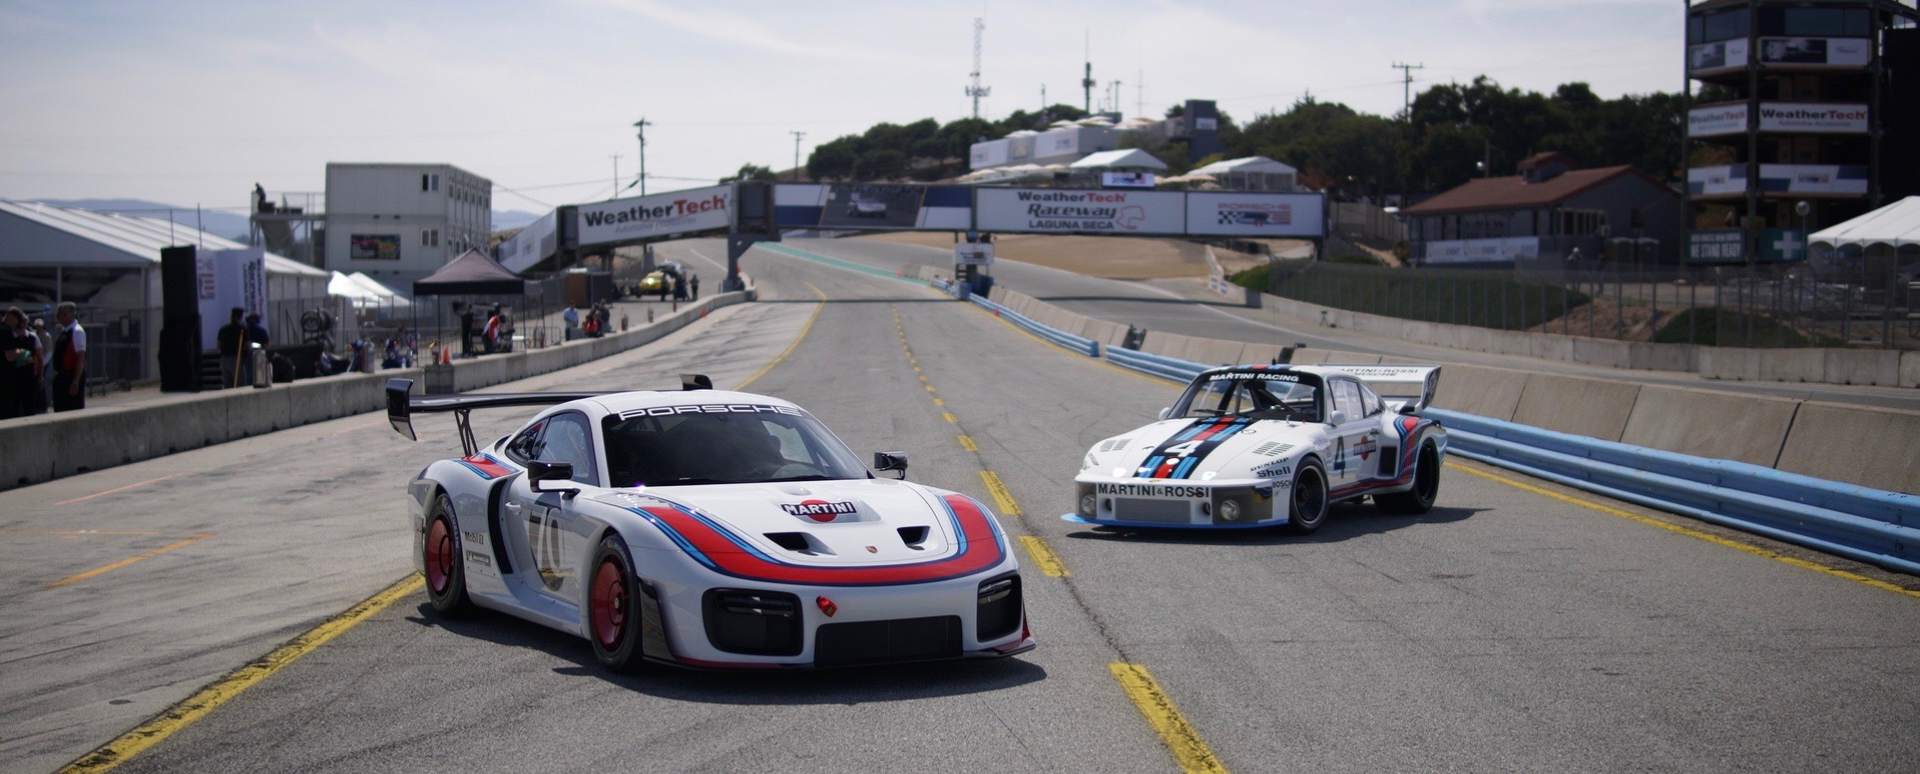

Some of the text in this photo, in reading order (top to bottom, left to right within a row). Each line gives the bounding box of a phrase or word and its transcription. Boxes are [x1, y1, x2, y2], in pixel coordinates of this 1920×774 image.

[1761, 109, 1865, 120] WeatherTech
[1018, 191, 1125, 202] WeatherTech
[584, 195, 725, 227] WeatherTech
[1027, 203, 1117, 219] Raceway
[1028, 220, 1115, 230] LAGUNA SECA
[1209, 372, 1299, 382] MARTINI RACING
[618, 404, 802, 421] PORSCHE
[1164, 440, 1204, 458] 4
[1334, 435, 1345, 479] 4
[1256, 466, 1291, 478] Shell
[784, 502, 854, 515] MARTINI
